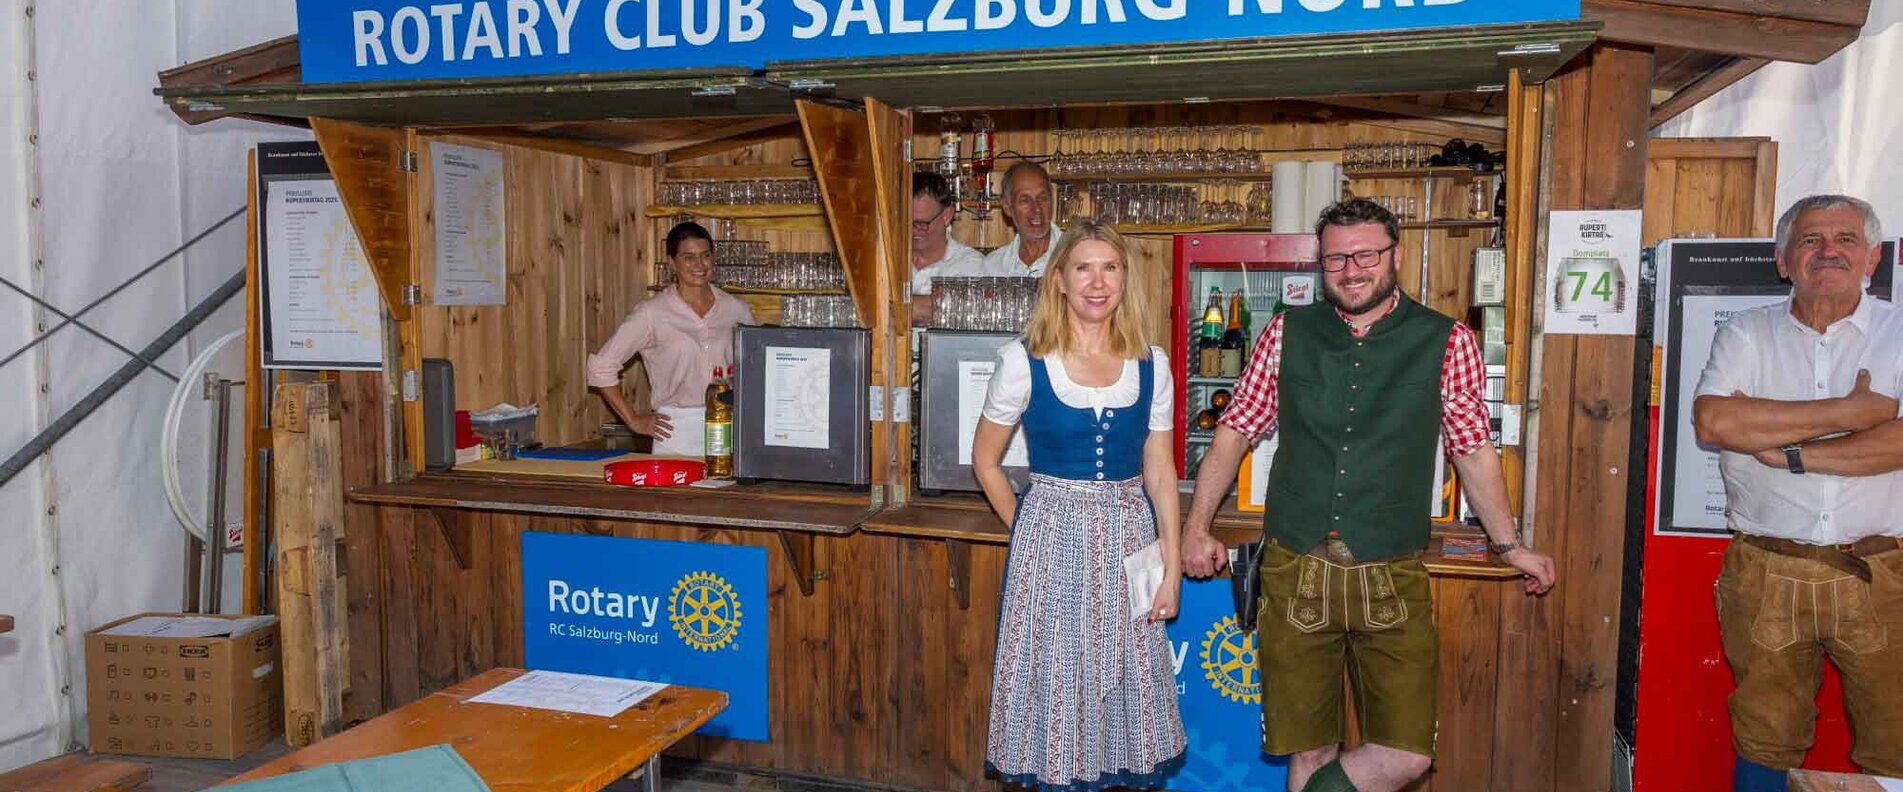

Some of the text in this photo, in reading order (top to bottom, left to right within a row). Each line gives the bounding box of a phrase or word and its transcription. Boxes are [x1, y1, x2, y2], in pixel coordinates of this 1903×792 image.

[353, 0, 1186, 66] ROTARY CLUB SALZ
[1567, 272, 1613, 302] 74
[548, 580, 660, 628] Rotary
[549, 623, 659, 645] RC Salzburg-Nord
[680, 623, 732, 643] INTERNATIONAL
